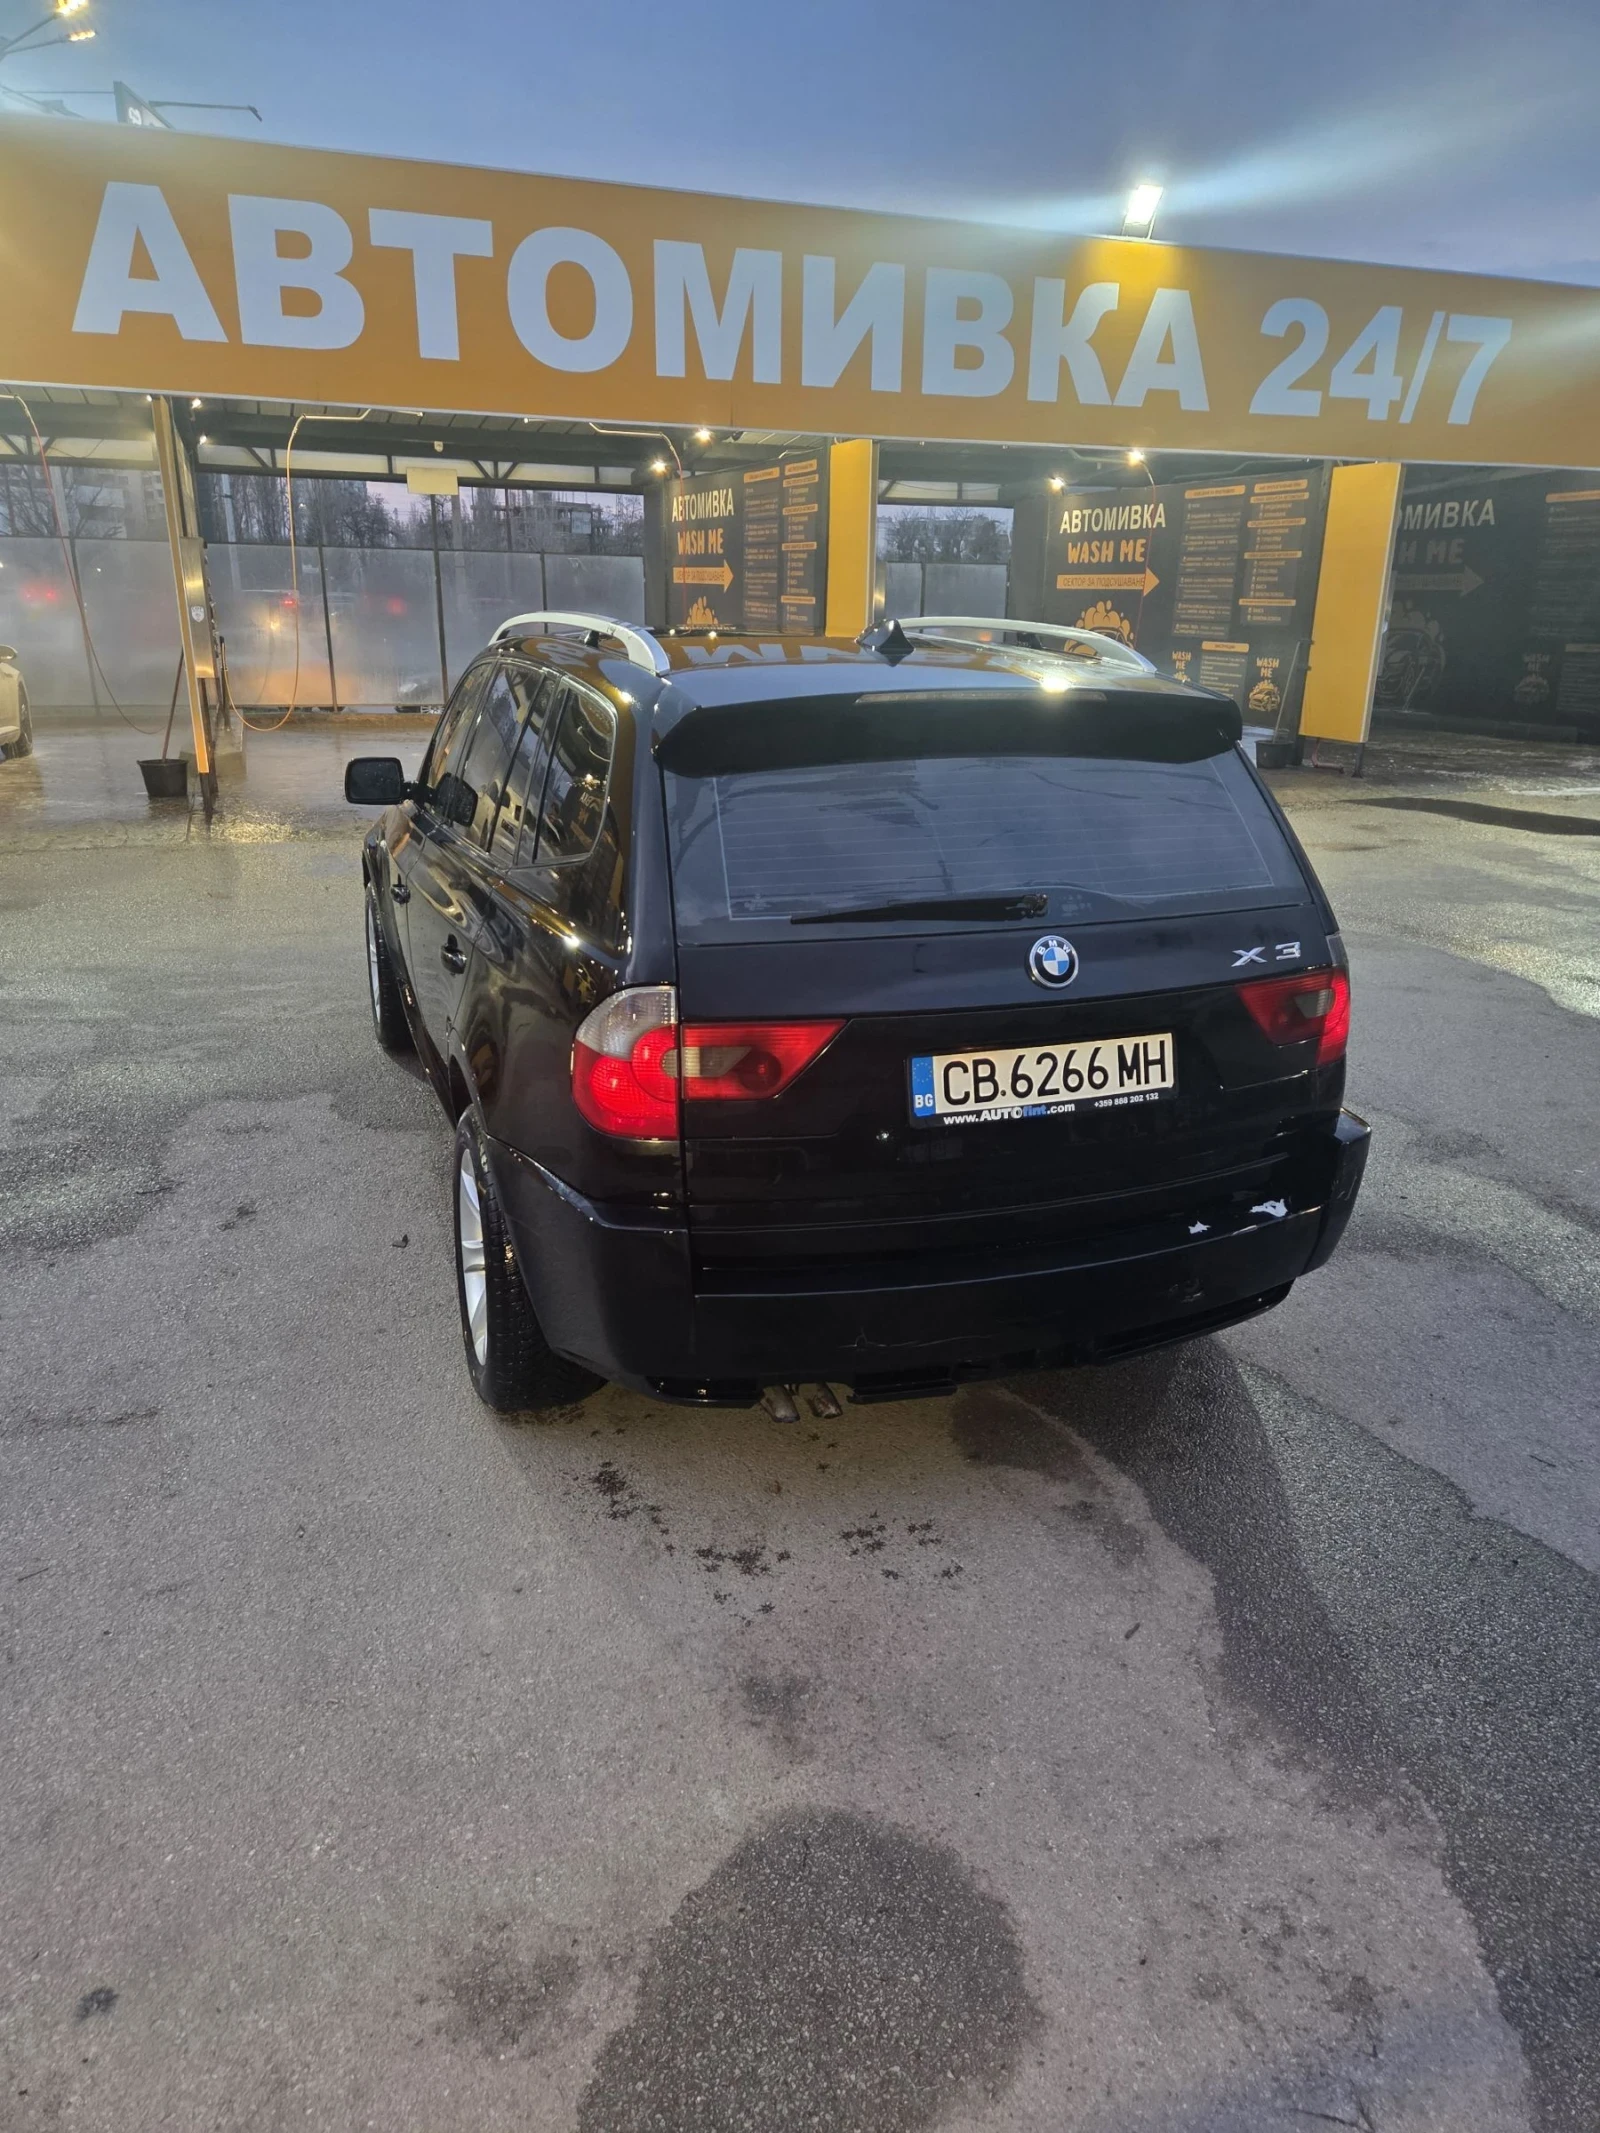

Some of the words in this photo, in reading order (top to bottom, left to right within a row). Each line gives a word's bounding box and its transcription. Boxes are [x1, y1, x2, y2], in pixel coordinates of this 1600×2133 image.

[72, 181, 1210, 412] АВТОМИВКА
[1248, 298, 1513, 426] 24/7
[671, 489, 734, 523] АВТОМИВКА
[1396, 498, 1495, 530] МИВКА
[1060, 503, 1166, 534] АВТОМИВКА
[677, 529, 705, 555] WASH
[708, 527, 724, 554] ME
[1068, 540, 1114, 564] WASH
[1120, 539, 1146, 563] ME
[1063, 577, 1086, 588] СЕКТОР
[1172, 651, 1192, 661] WASH
[1175, 661, 1186, 670] ME
[1256, 657, 1280, 668] WASH
[1260, 668, 1274, 678] ME
[1034, 939, 1071, 961] BMW
[1010, 1046, 1109, 1099] 6266
[1117, 1040, 1167, 1088] MH
[914, 1094, 933, 1109] BG
[1094, 1098, 1113, 1108] +359
[1114, 1096, 1128, 1106] 888
[1129, 1094, 1144, 1104] 202
[1145, 1092, 1160, 1101] 132
